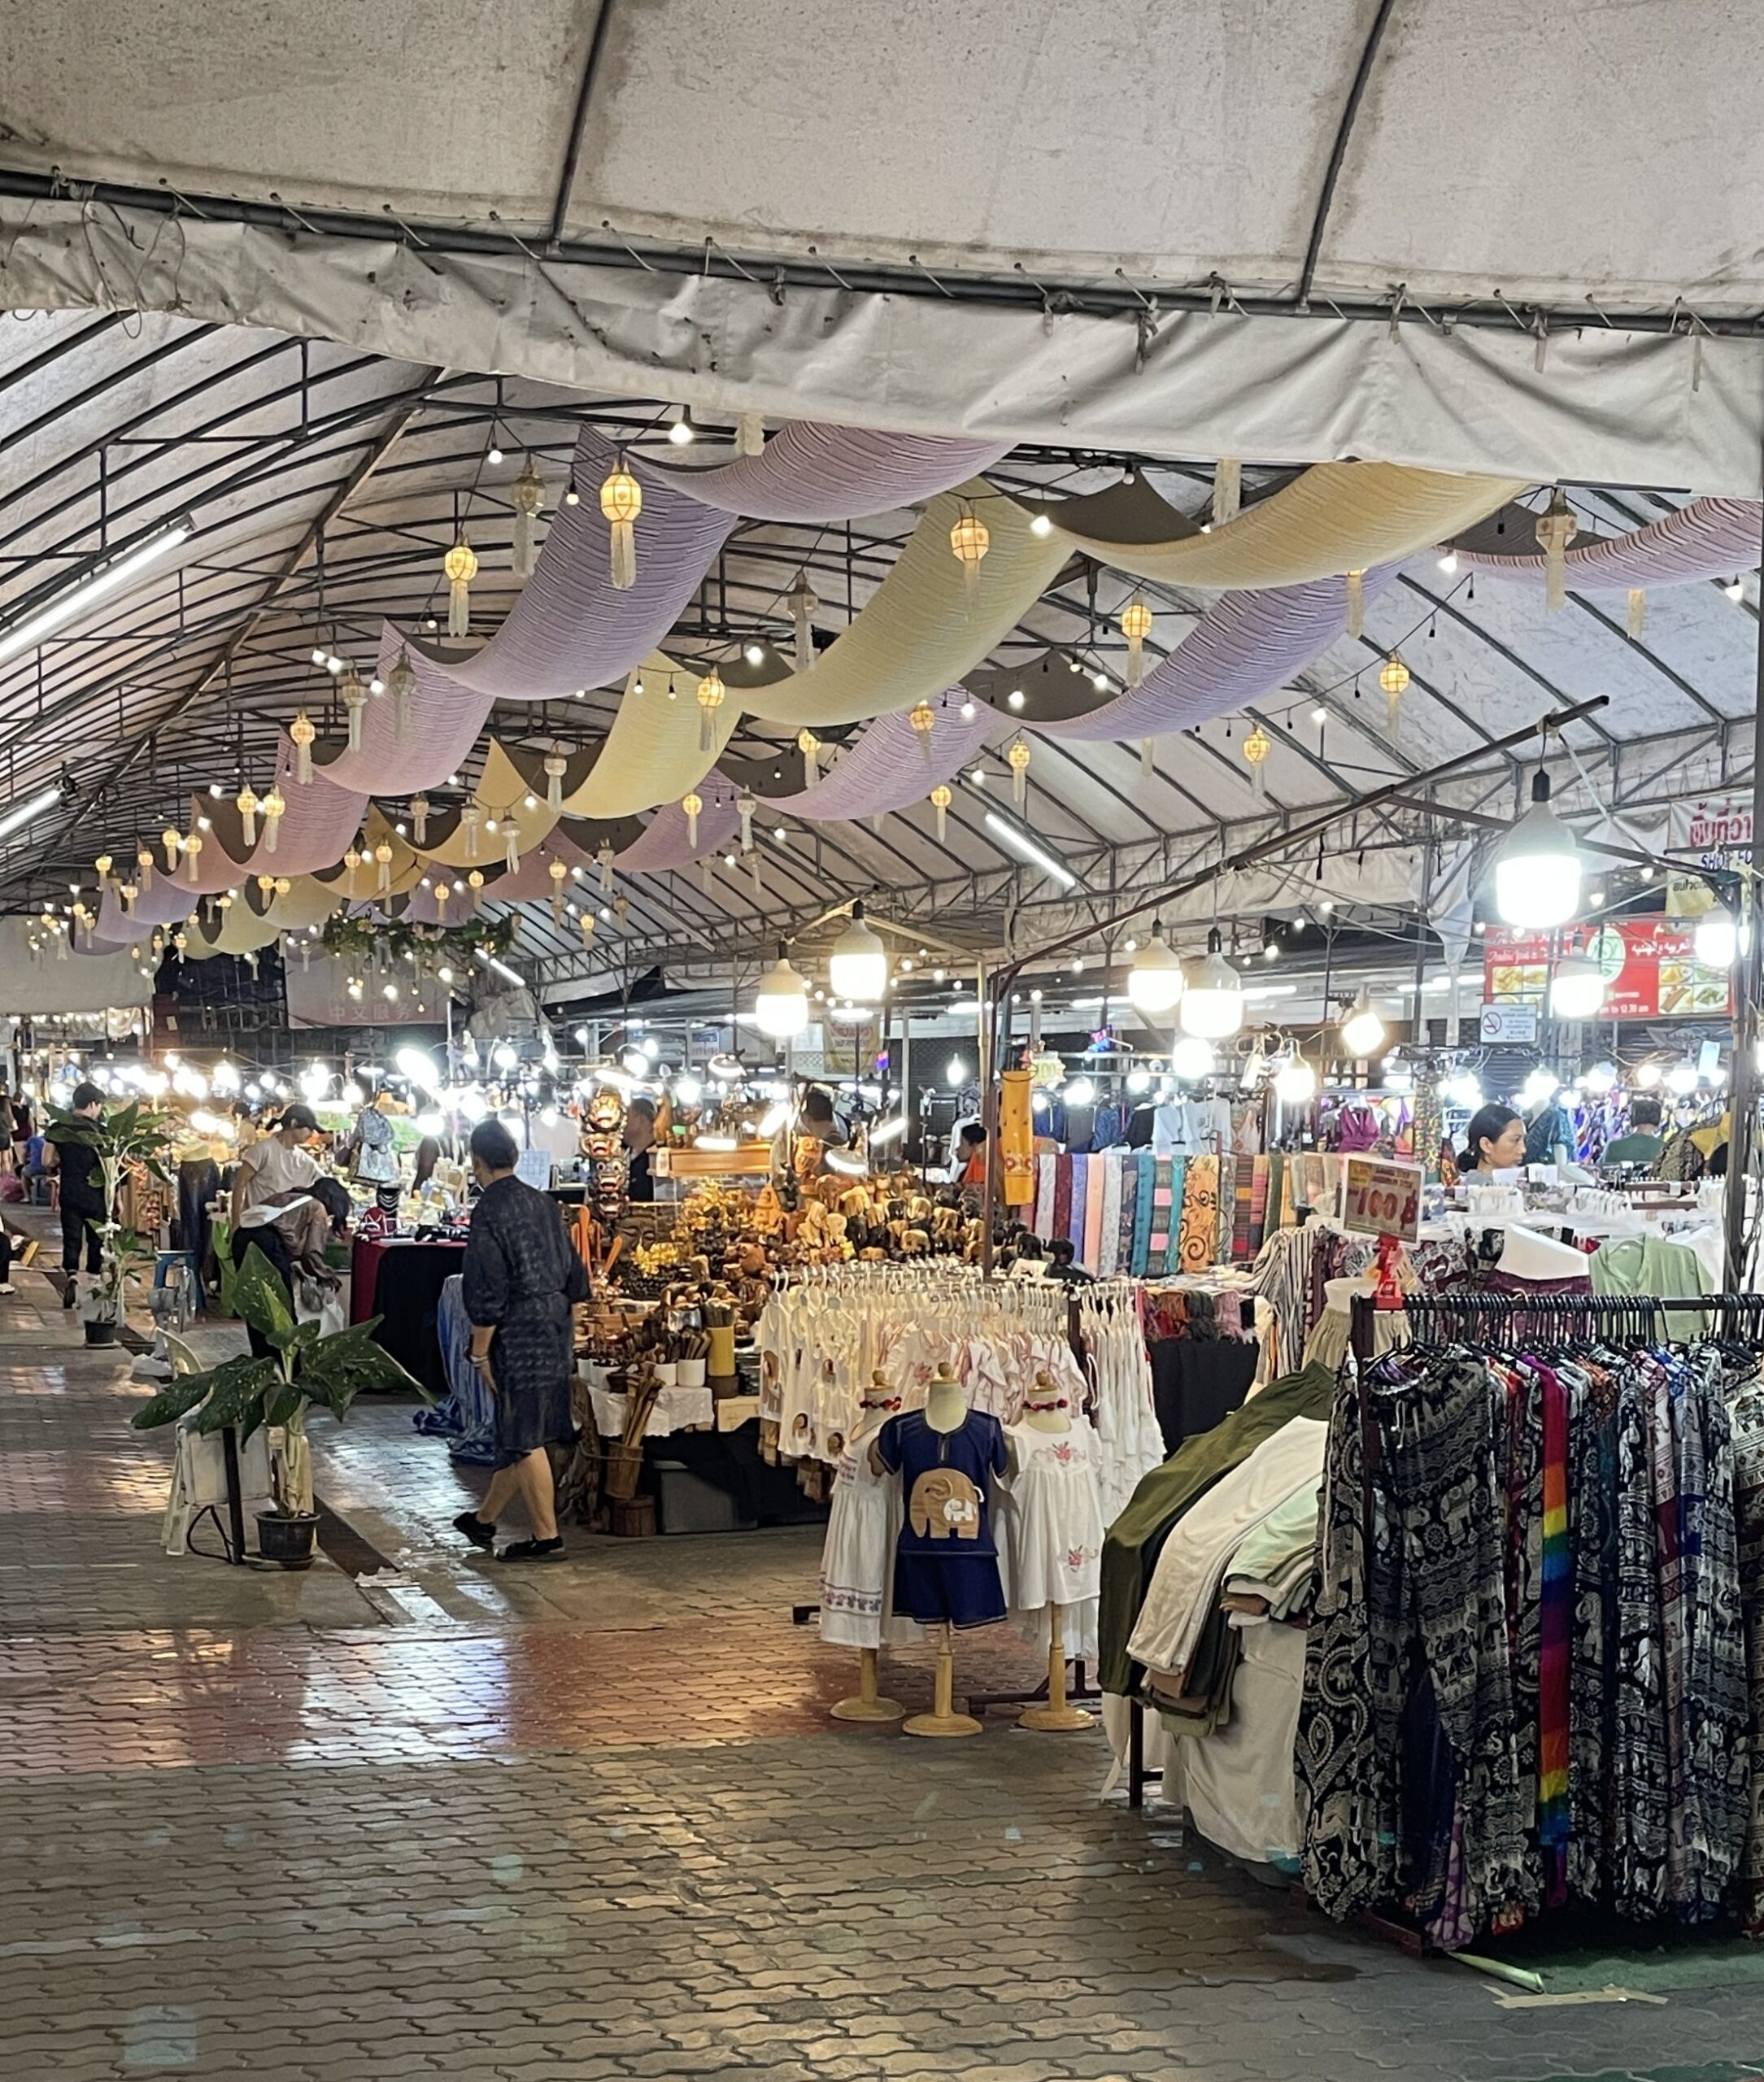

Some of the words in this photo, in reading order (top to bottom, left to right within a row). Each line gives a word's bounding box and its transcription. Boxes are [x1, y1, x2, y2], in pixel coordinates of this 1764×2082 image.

[1690, 797, 1752, 847] พื้นที่ว่า
[1357, 1187, 1398, 1220] 100
